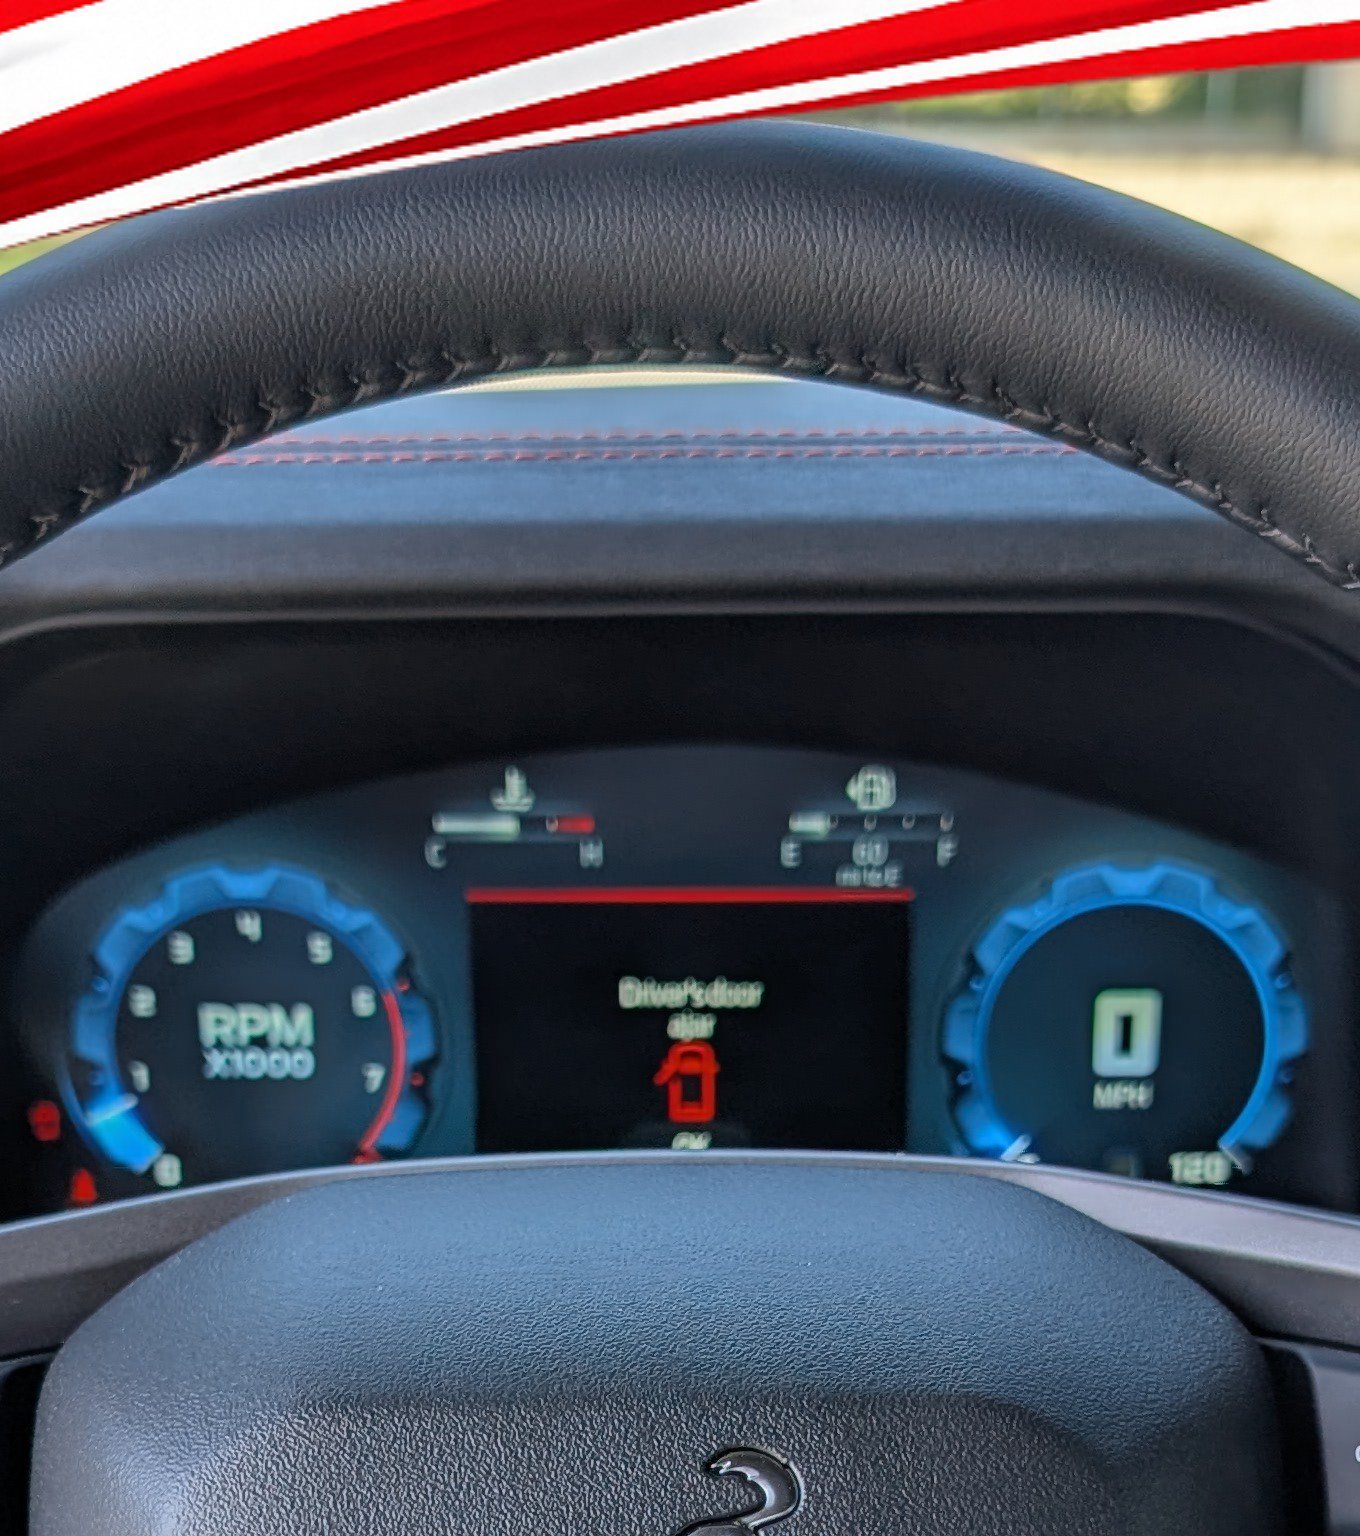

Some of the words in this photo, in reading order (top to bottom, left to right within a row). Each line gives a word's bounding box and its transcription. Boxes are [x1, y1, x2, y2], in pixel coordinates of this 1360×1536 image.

[197, 1002, 315, 1048] RPM
[1093, 989, 1162, 1077] 0
[361, 1062, 386, 1094] 7
[1092, 1079, 1154, 1111] MPH
